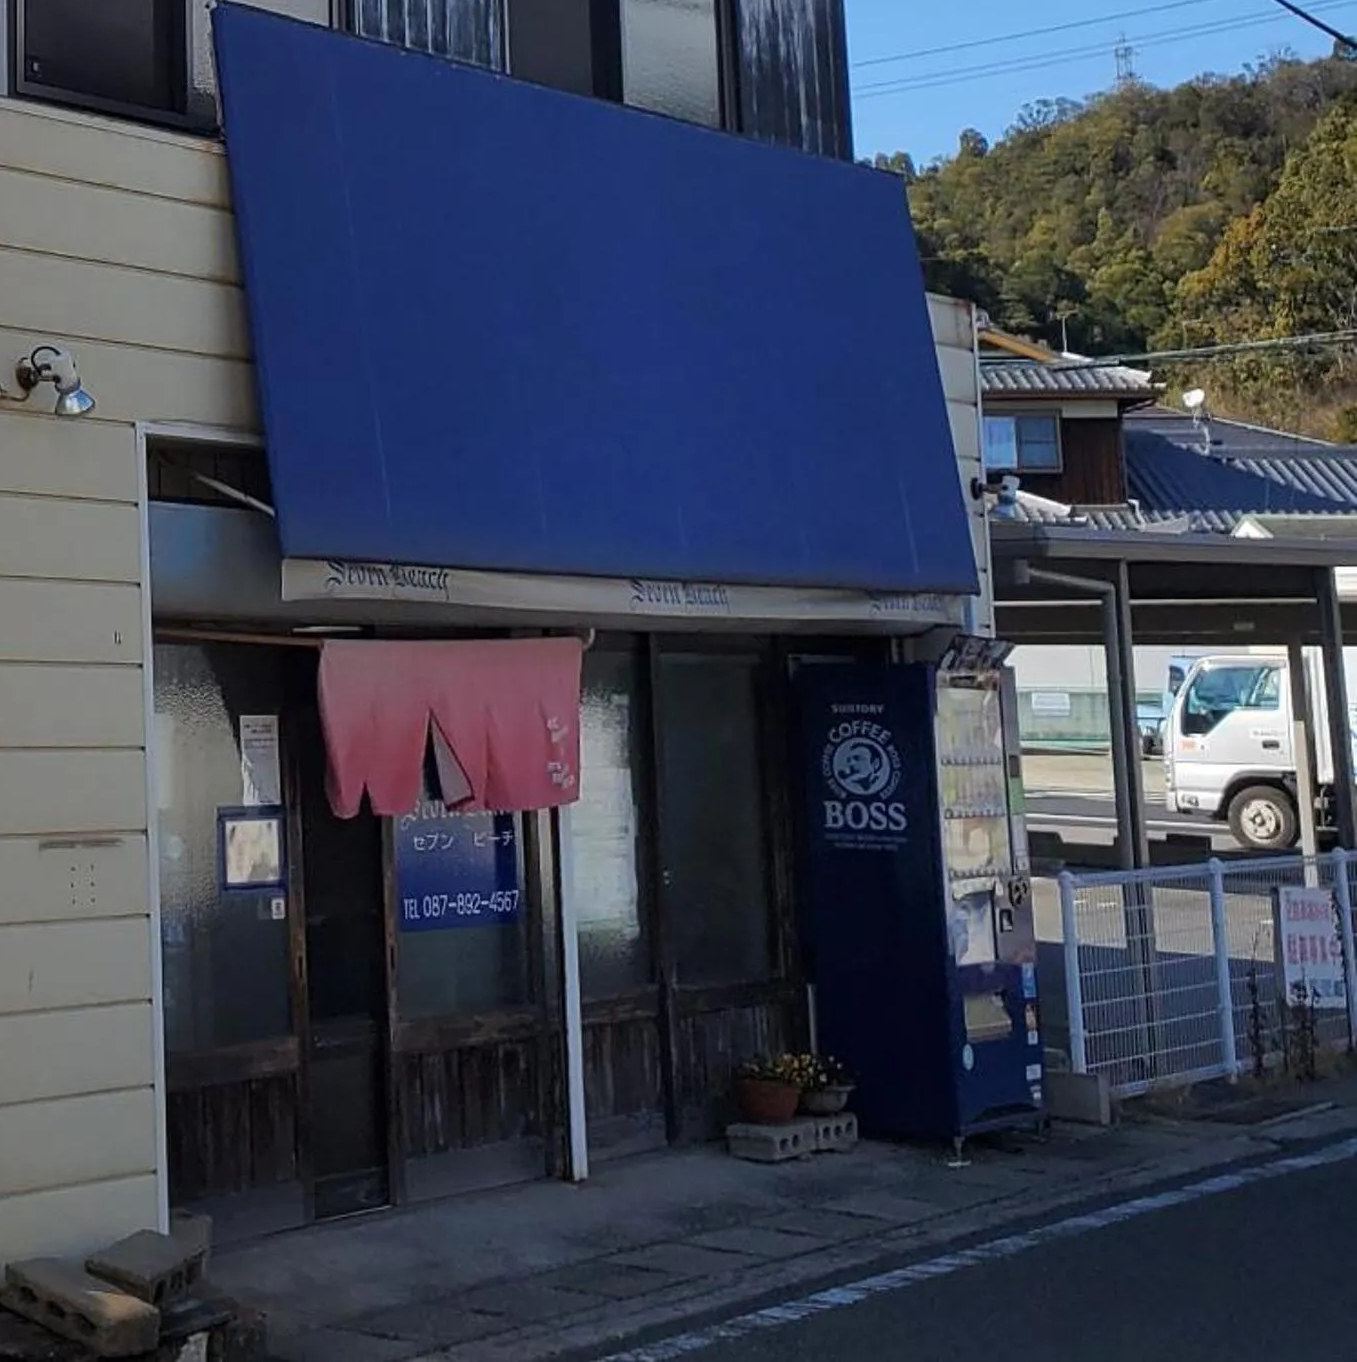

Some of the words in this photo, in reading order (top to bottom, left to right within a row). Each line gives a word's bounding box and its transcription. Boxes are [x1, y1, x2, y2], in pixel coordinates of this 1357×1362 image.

[830, 703, 885, 715] SUNTORY
[828, 720, 892, 744] COFFEE
[822, 800, 908, 831] BOSS
[413, 833, 454, 851] セブン
[403, 898, 420, 920] TEL
[422, 889, 519, 917] 087-892-4567
